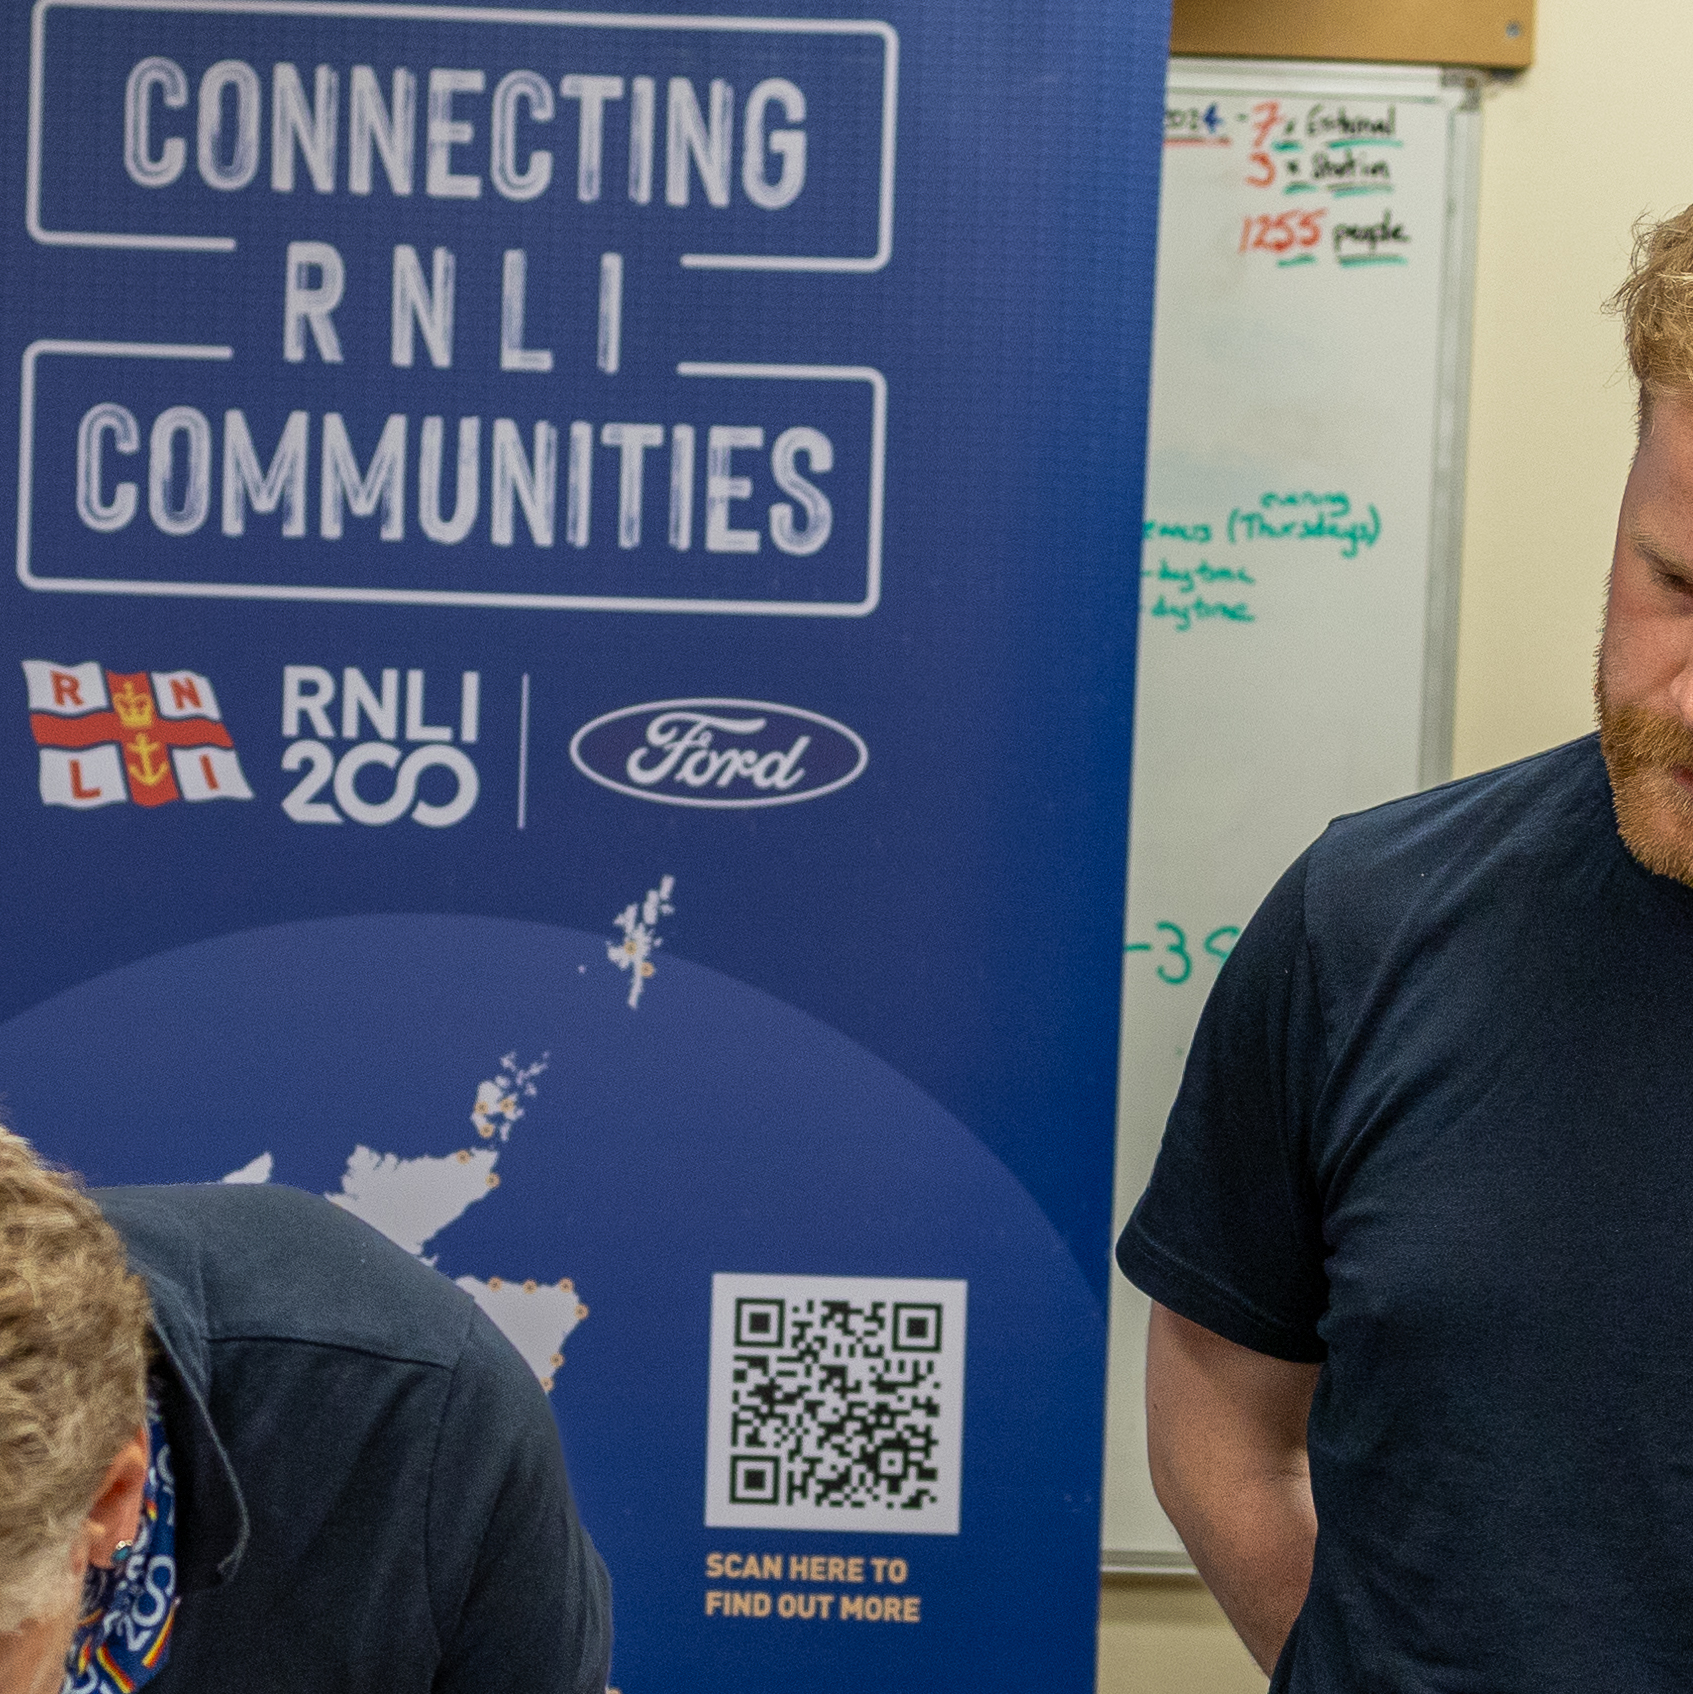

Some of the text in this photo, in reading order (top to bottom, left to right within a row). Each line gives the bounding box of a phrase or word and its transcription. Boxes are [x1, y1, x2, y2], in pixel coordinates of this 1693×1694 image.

[123, 57, 808, 209] CONNECTING
[1238, 207, 1328, 255] 1255
[283, 240, 623, 374] RNLI
[76, 402, 835, 556] COMMUNITIES
[281, 666, 480, 744] RNLI
[280, 742, 480, 827] 200
[627, 710, 810, 792] Ford
[705, 1591, 922, 1624] FIND OUT MORE
[706, 1552, 909, 1585] SCAN HERE TO
